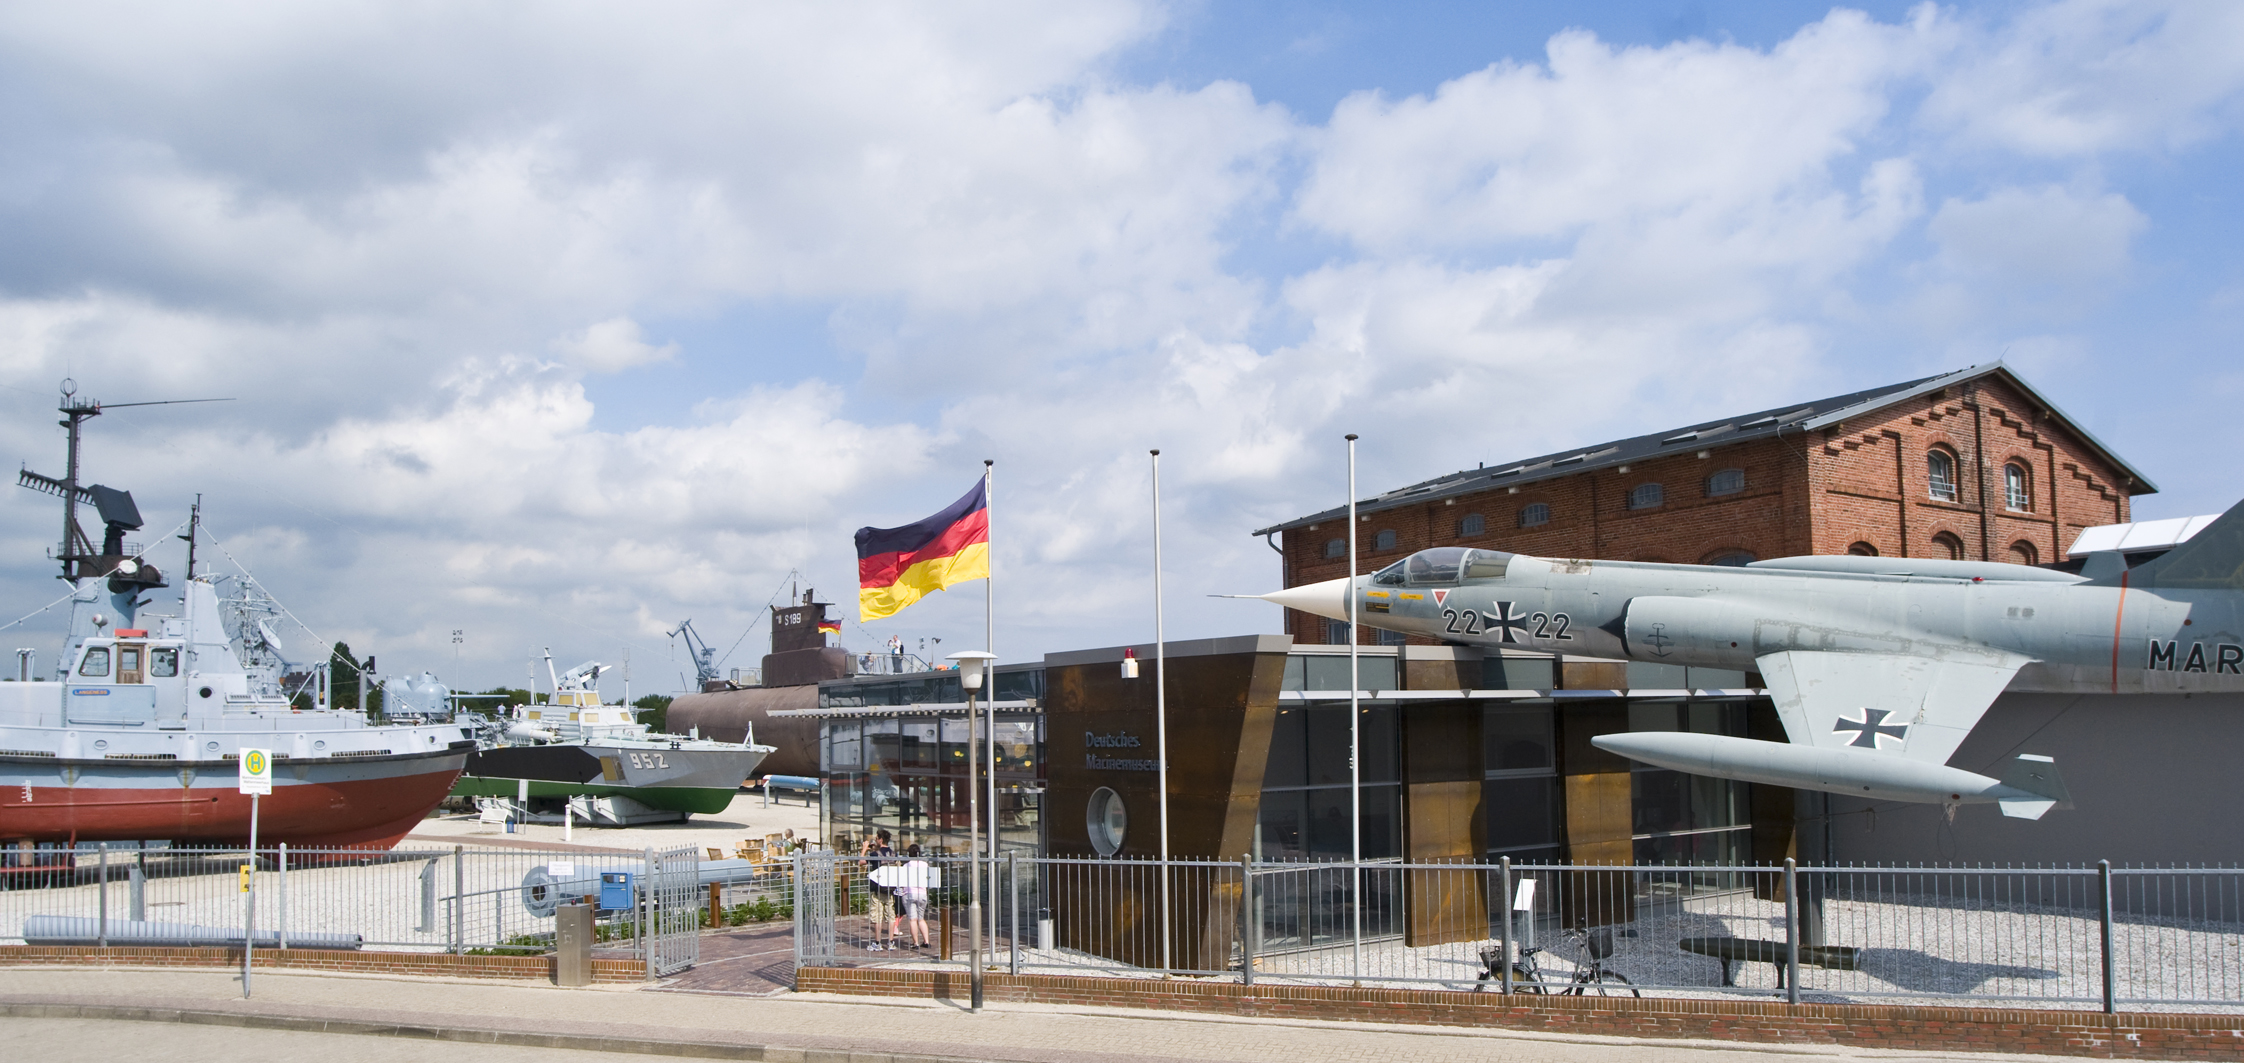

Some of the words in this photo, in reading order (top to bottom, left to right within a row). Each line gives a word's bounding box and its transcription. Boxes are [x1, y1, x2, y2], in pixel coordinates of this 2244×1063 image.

[1442, 608, 1482, 636] 22
[1531, 611, 1574, 640] 22
[2148, 638, 2244, 675] MAR
[1085, 730, 1140, 748] Deutsches
[629, 753, 670, 769] 952
